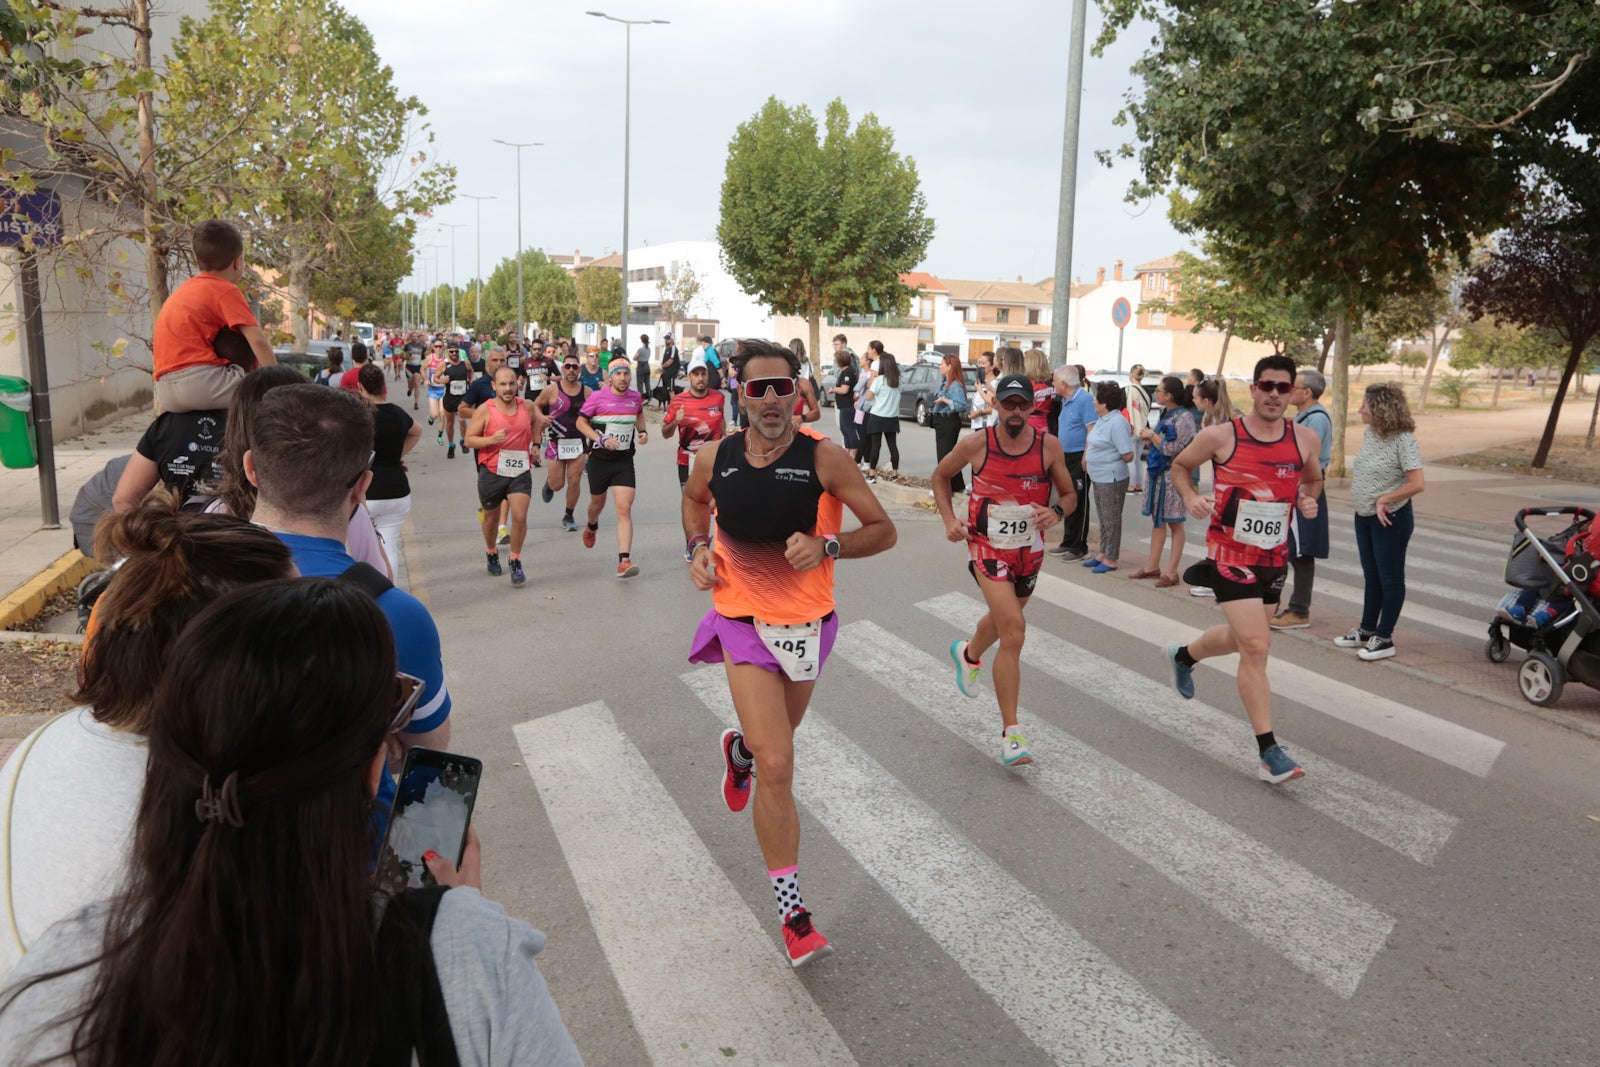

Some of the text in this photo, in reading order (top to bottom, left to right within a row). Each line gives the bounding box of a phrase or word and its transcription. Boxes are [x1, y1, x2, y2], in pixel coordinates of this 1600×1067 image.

[586, 324, 594, 333] P
[560, 446, 580, 454] 3061
[505, 459, 524, 469] 525
[998, 520, 1028, 535] 219
[1241, 518, 1282, 536] 3068
